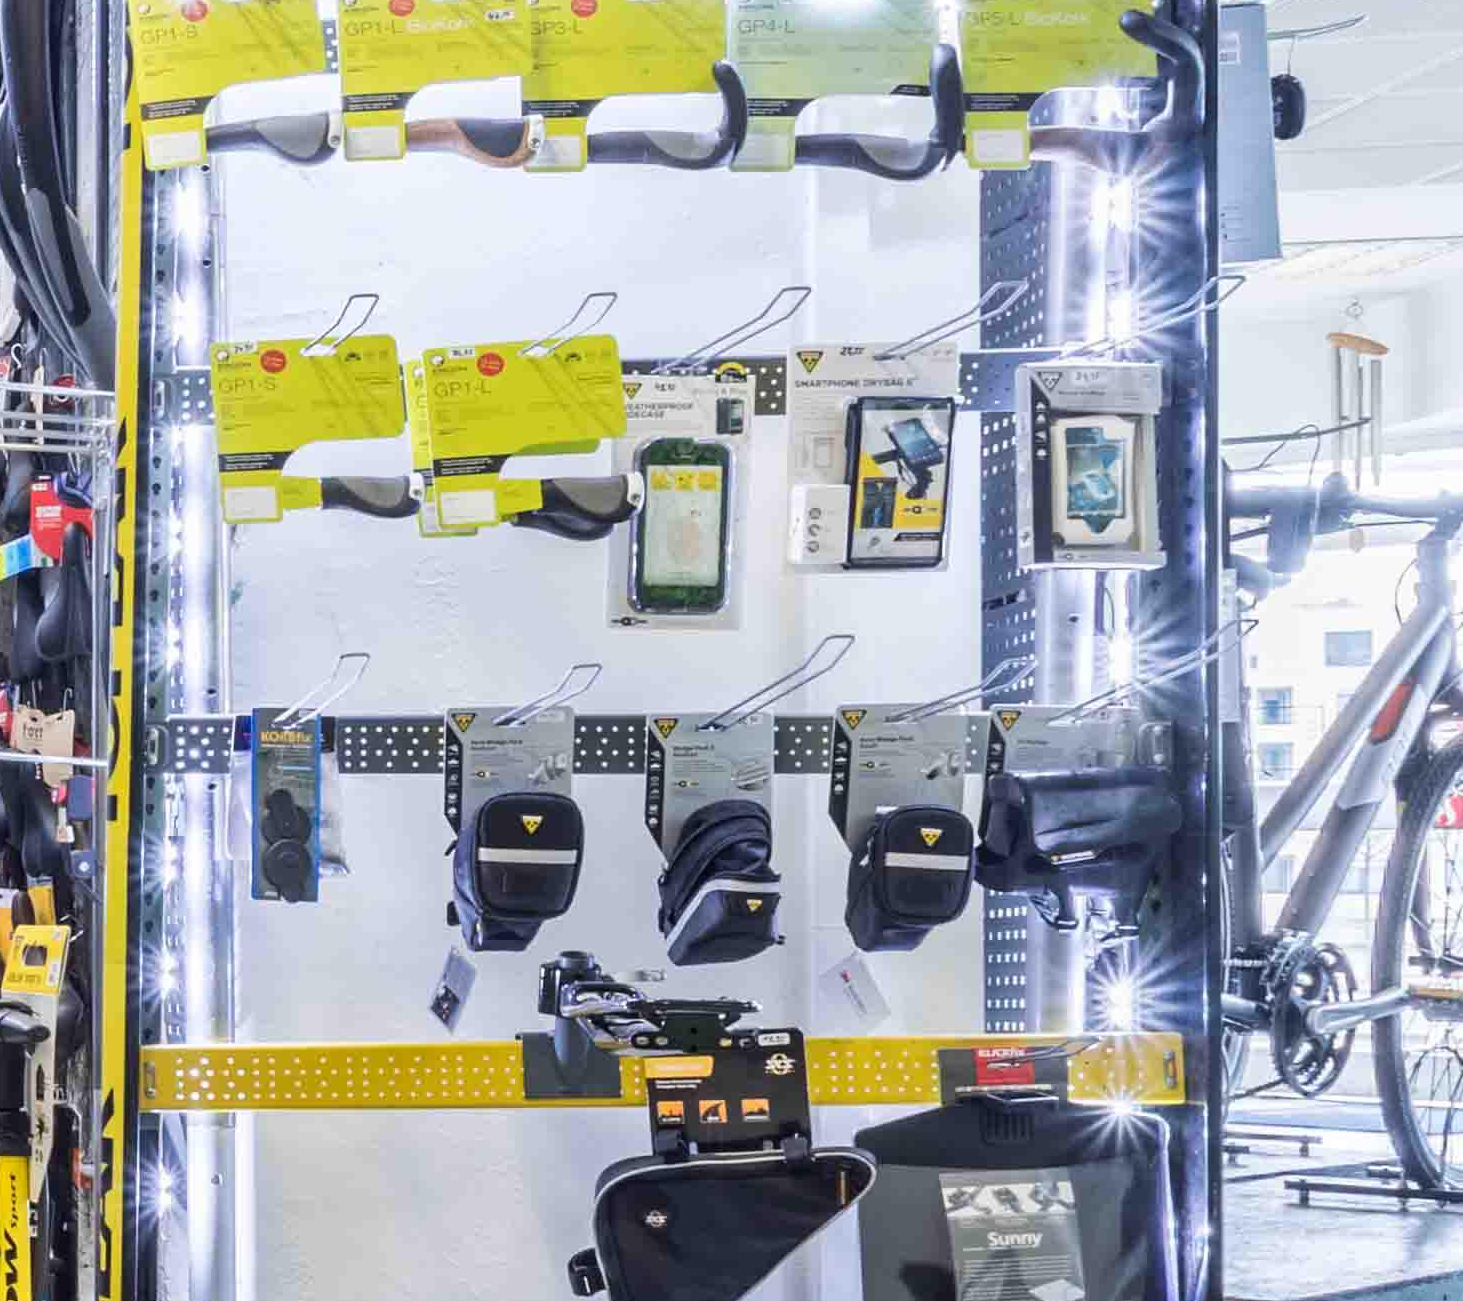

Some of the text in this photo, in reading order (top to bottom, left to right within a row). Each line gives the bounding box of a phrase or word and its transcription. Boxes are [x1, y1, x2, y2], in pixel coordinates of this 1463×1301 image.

[344, 18, 404, 37] GP1-L
[737, 18, 795, 35] GP4-L
[218, 378, 277, 394] GP1-S
[433, 380, 492, 398] GP1-L
[794, 379, 860, 388] SMARTPHONE
[986, 1231, 1043, 1248] Sunny
